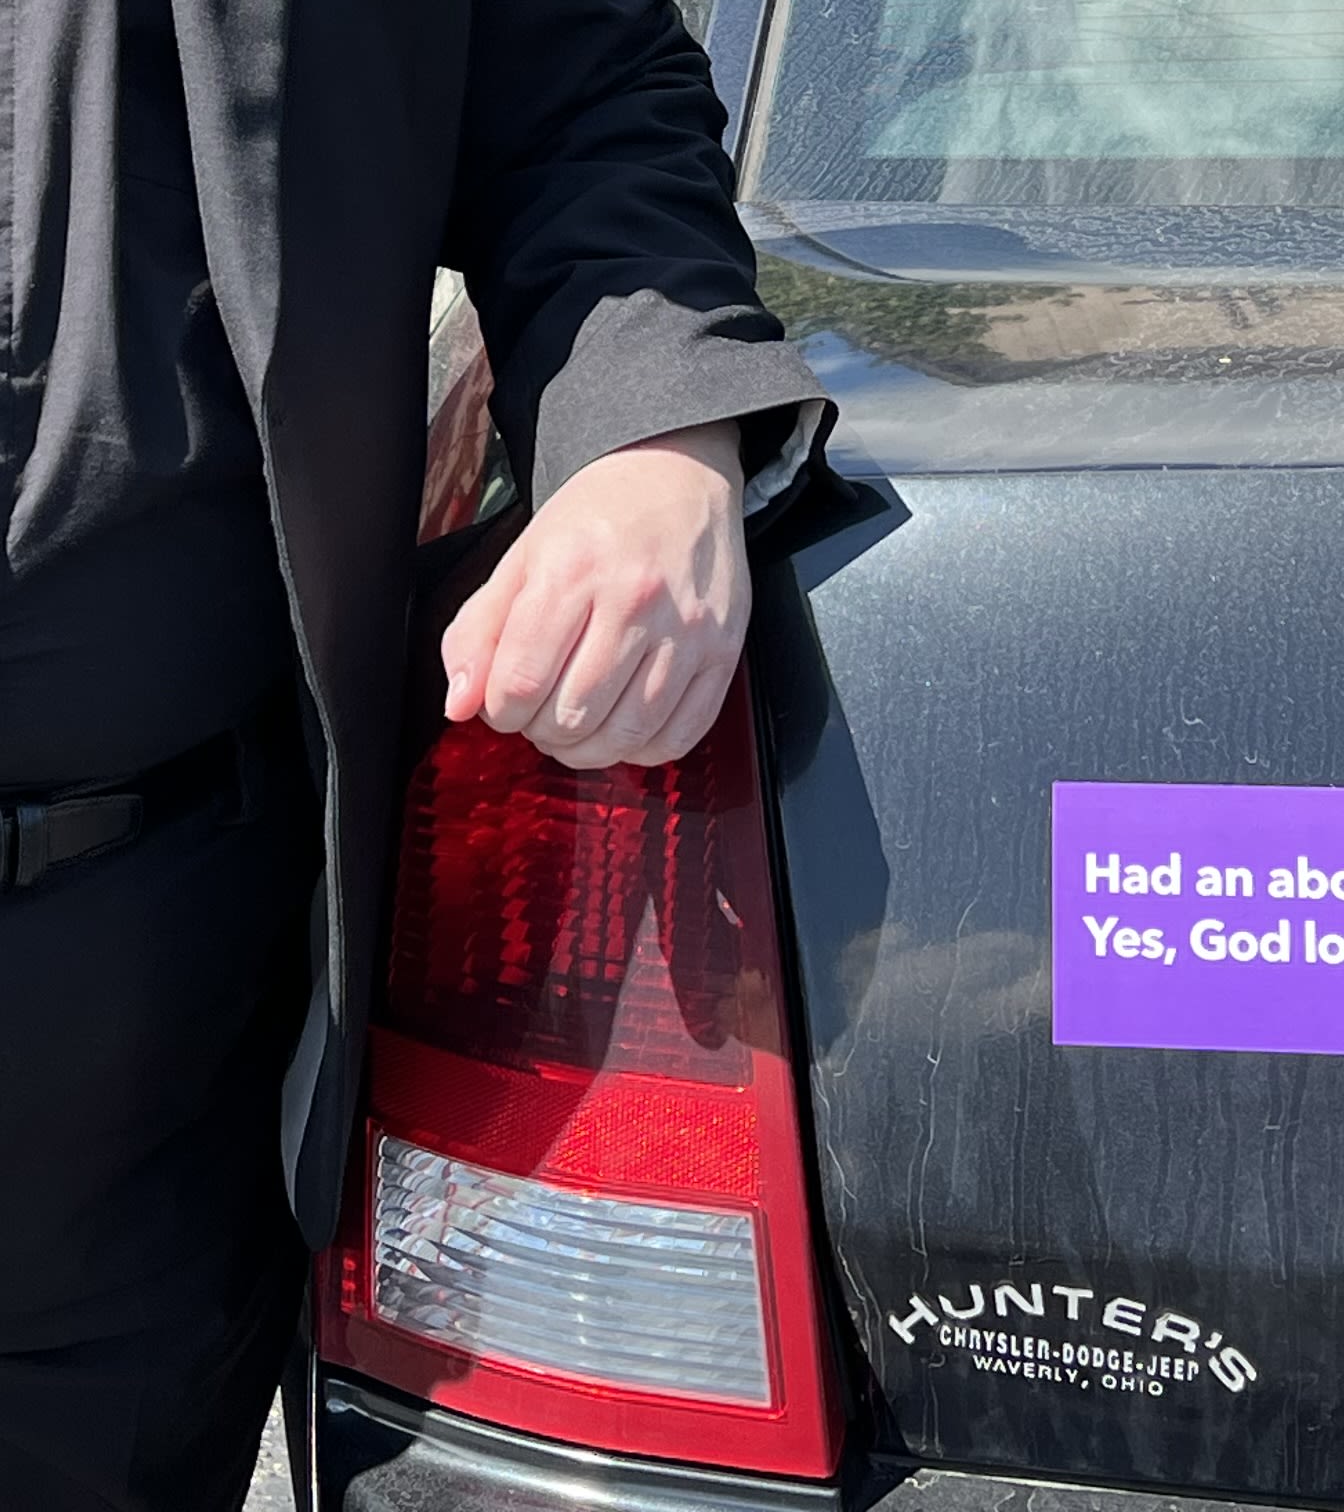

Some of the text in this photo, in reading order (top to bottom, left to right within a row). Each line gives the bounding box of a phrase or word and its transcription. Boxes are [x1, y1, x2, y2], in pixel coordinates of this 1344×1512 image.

[1085, 851, 1182, 896] Had
[1195, 865, 1254, 898] an
[1082, 915, 1177, 966] Yes,
[1189, 918, 1291, 964] God
[888, 1283, 1257, 1393] HUNTER'S
[972, 1354, 1164, 1397] WAVERLY, OHIO
